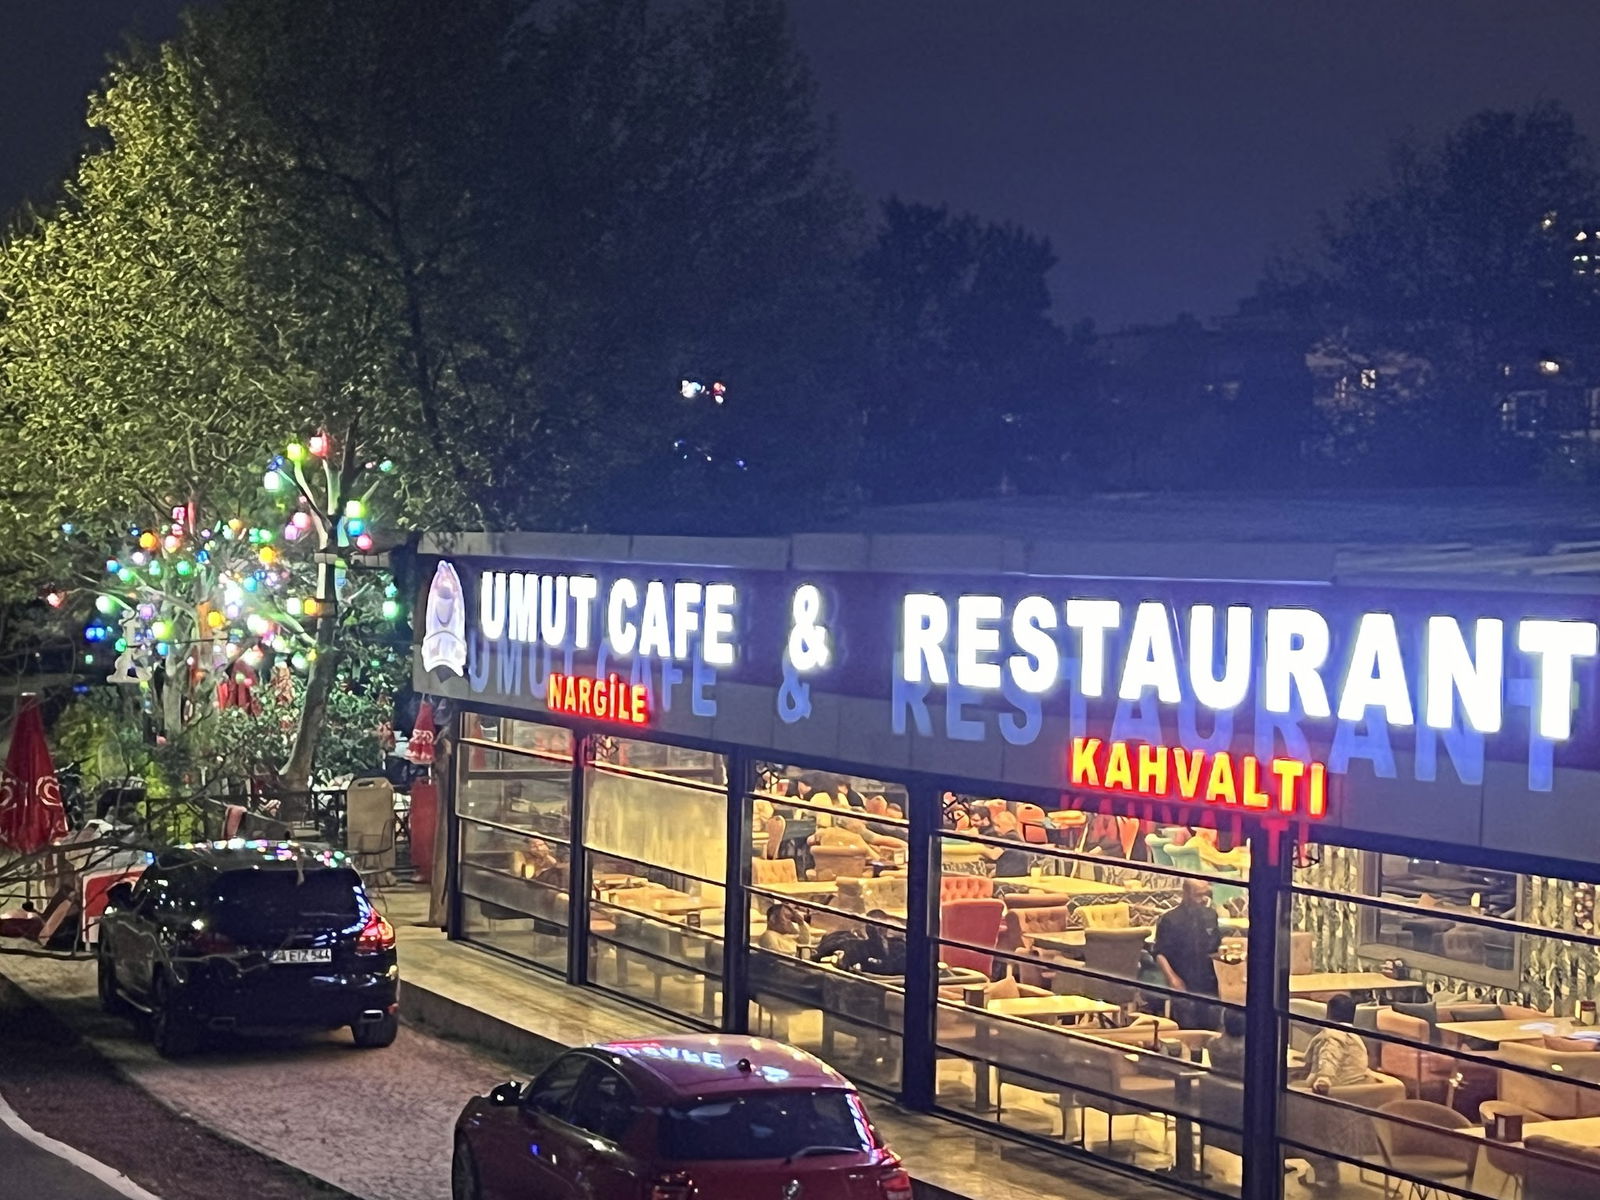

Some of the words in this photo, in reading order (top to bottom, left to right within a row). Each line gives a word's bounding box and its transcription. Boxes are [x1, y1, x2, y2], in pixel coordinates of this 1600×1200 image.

[480, 570, 598, 649] UMUT
[607, 577, 736, 665] CAFE
[787, 584, 830, 671] &
[902, 592, 1598, 741] RESTAURANT
[546, 673, 650, 725] NARGİLE
[1069, 737, 1327, 817] KAHVALTI
